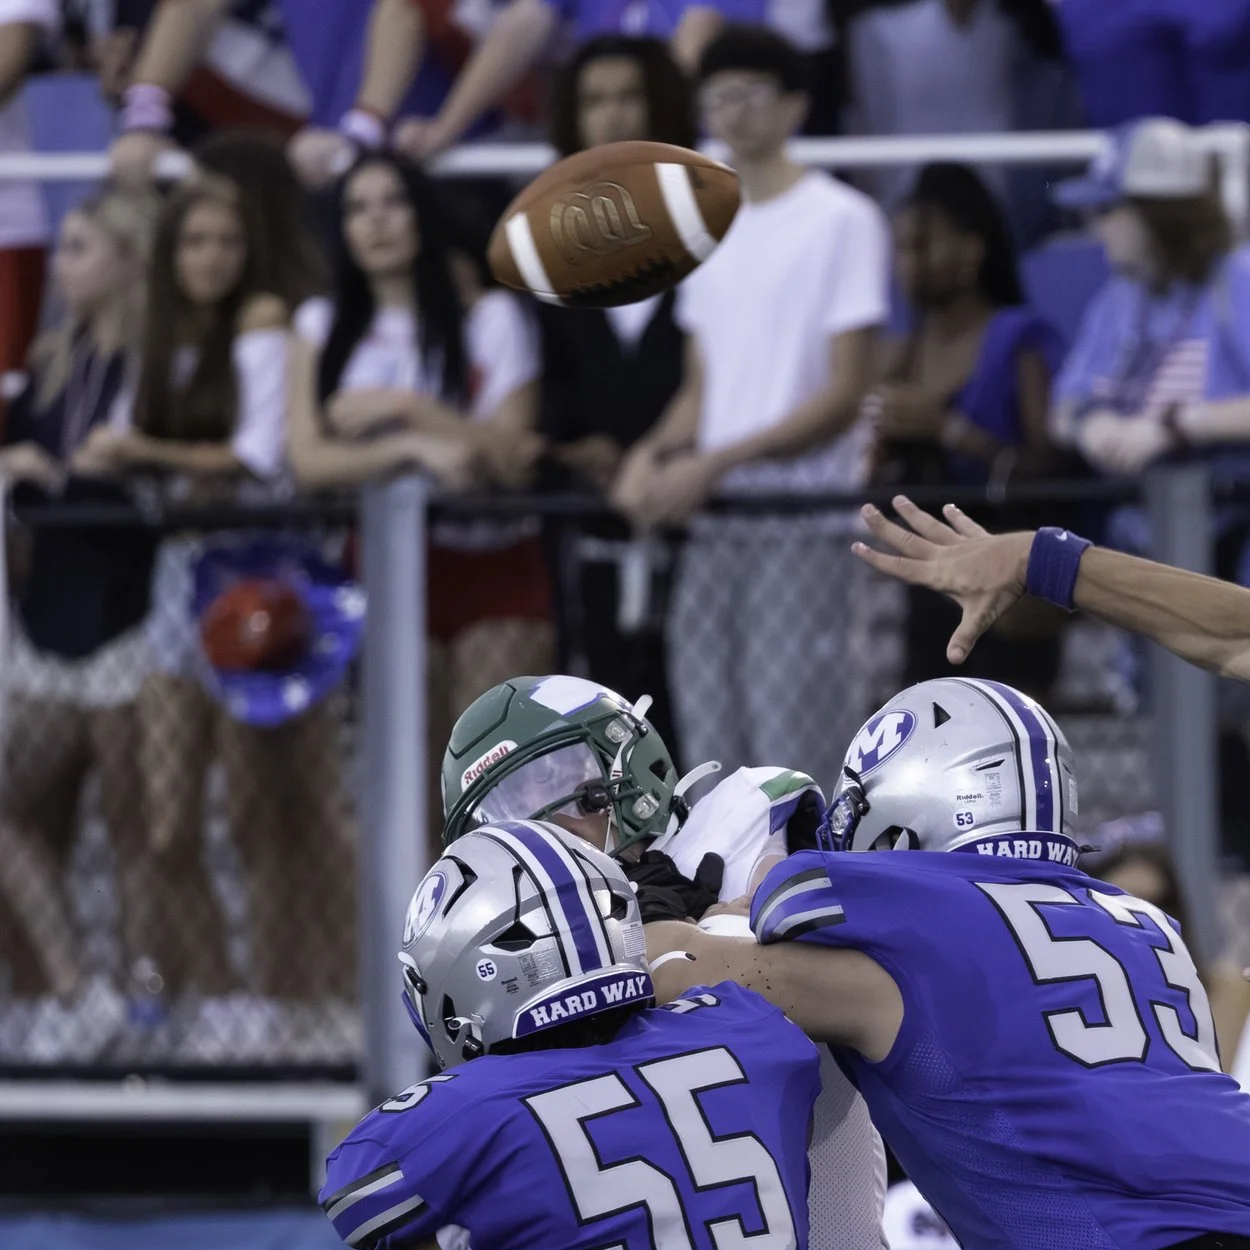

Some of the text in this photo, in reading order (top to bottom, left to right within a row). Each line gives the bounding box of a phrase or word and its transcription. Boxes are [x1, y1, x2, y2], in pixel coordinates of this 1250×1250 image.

[849, 711, 907, 772] M
[463, 745, 510, 785] Riddell
[956, 792, 983, 801] Riddell
[955, 811, 975, 827] 53
[976, 840, 1079, 868] HARD WAY
[477, 961, 495, 978] 55
[969, 880, 1222, 1073] 53
[529, 989, 598, 1027] HARD
[601, 975, 647, 1004] WAY
